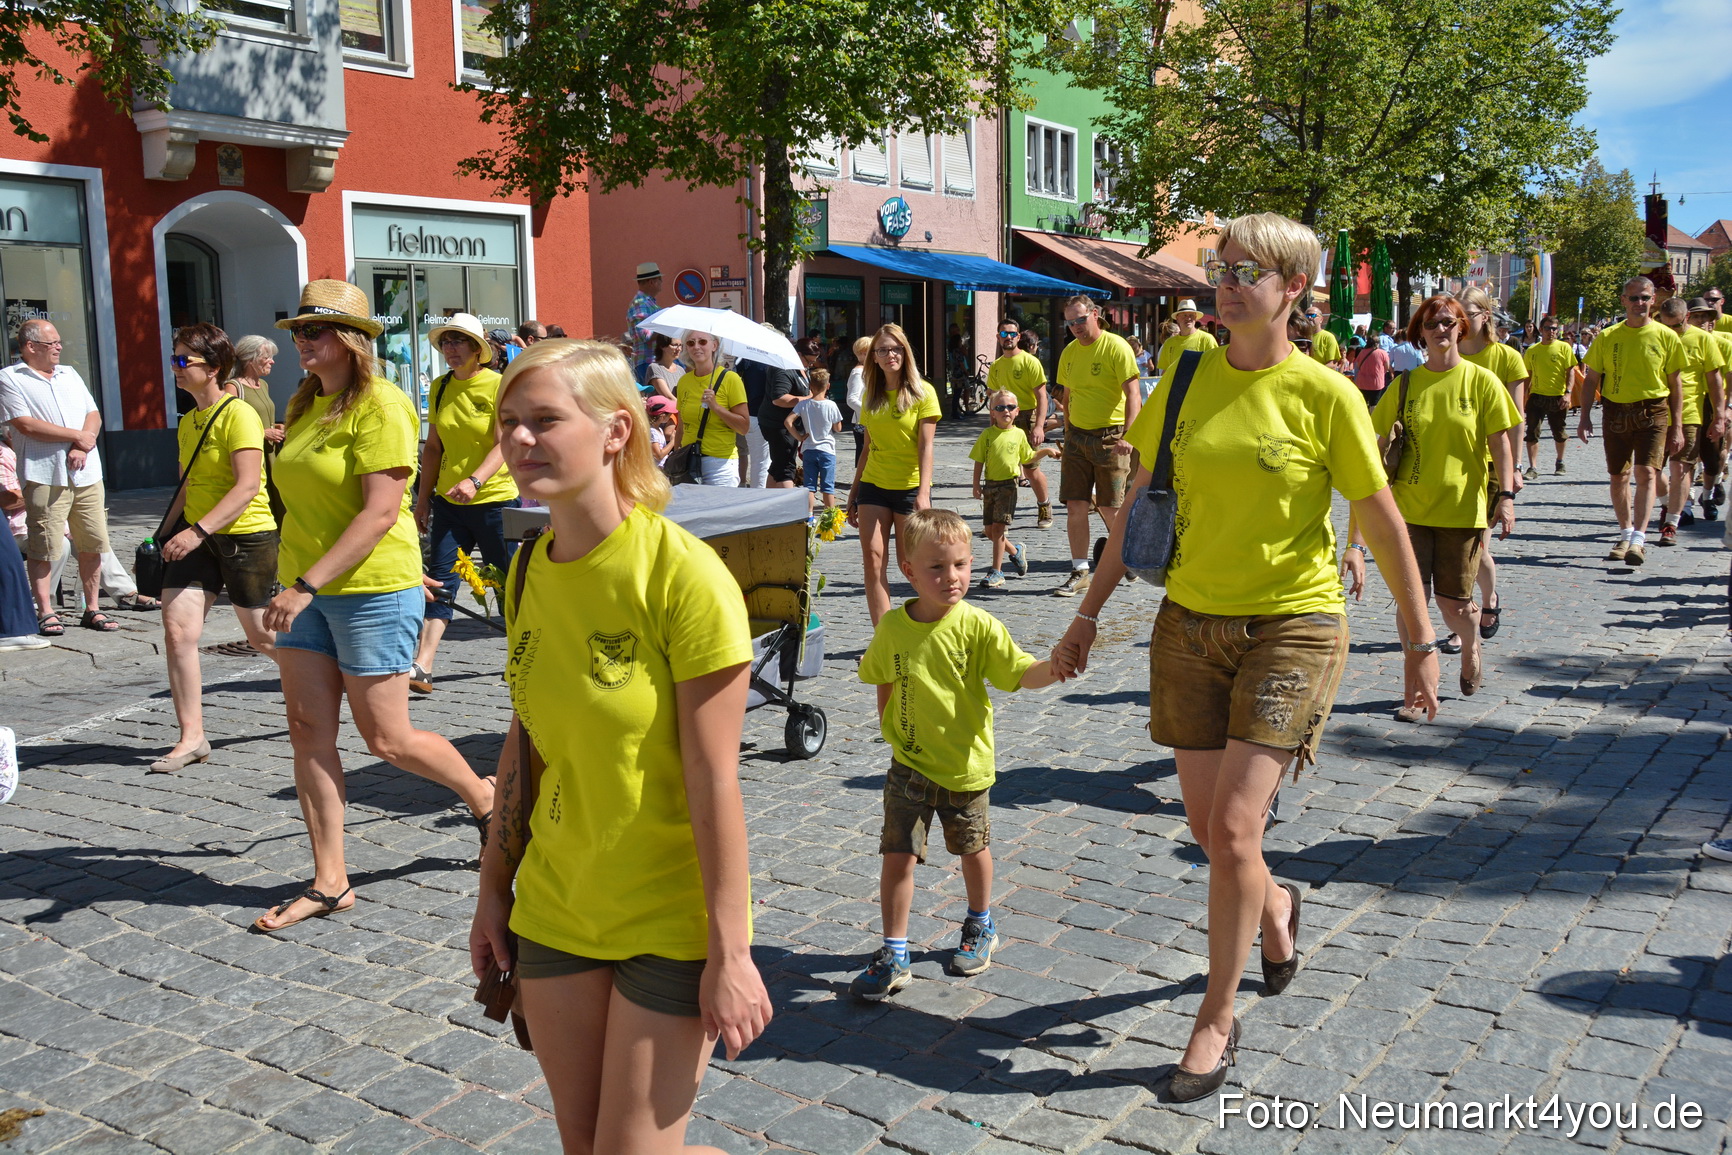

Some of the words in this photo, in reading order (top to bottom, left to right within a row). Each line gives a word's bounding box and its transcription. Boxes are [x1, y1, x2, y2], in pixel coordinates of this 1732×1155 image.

[880, 201, 898, 217] vom
[886, 210, 911, 233] FASS
[388, 224, 486, 257] fielmann
[510, 630, 532, 666] 2018
[516, 628, 542, 728] WEIDENWANG
[894, 653, 902, 677] 2018
